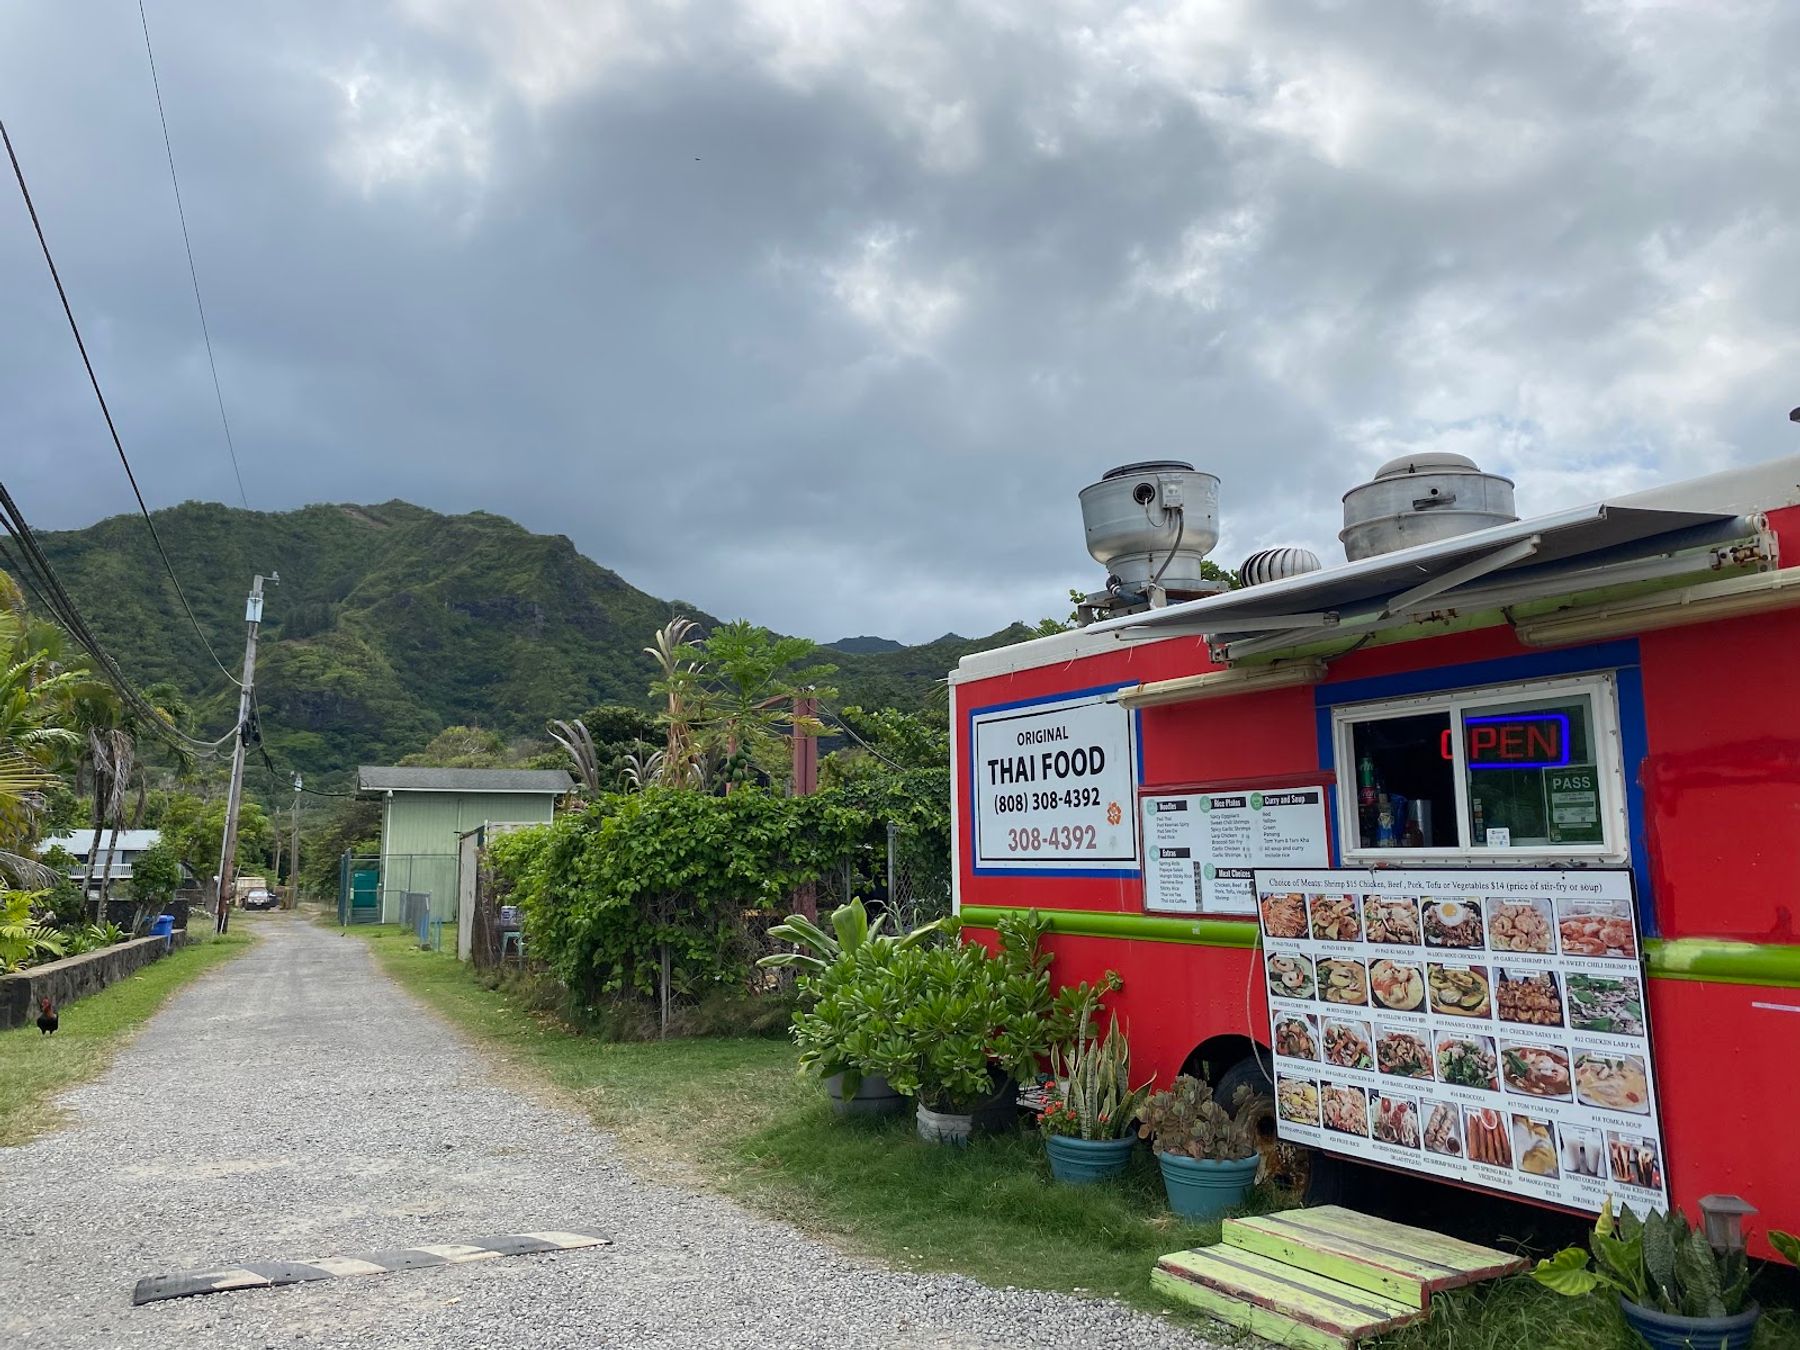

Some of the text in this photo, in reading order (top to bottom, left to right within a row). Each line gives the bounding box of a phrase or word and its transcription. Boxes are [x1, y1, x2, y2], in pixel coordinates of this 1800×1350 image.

[1017, 726, 1069, 746] ORIGINAL
[988, 746, 1105, 785] THAI FOOD
[1553, 777, 1591, 789] PASS
[994, 787, 1101, 815] (808) 308-4392
[1214, 799, 1225, 807] Rice
[1265, 797, 1280, 805] Curry
[1292, 795, 1305, 804] Soup
[1008, 824, 1097, 852] 308-4392
[1162, 849, 1177, 857] Extras
[1218, 869, 1230, 877] Meat
[1269, 878, 1291, 887] Choice
[1292, 879, 1300, 887] of
[1301, 879, 1323, 888] Meats:
[1324, 880, 1345, 889] Shrimp
[1346, 880, 1357, 888] $15
[1359, 880, 1386, 889] Chicken,
[1425, 881, 1441, 889] Tofu
[1452, 881, 1489, 891] Vegetables
[1491, 881, 1505, 890] $14
[1506, 882, 1528, 892] (price
[1530, 882, 1538, 890] of
[1540, 882, 1567, 892] stir-fry
[1580, 883, 1602, 893] soup)
[1508, 1028, 1533, 1036] CHICKEN
[1584, 1037, 1612, 1045] CHICKEN
[1458, 1092, 1485, 1101] BROCCOLI
[1625, 1120, 1642, 1129] SOUP
